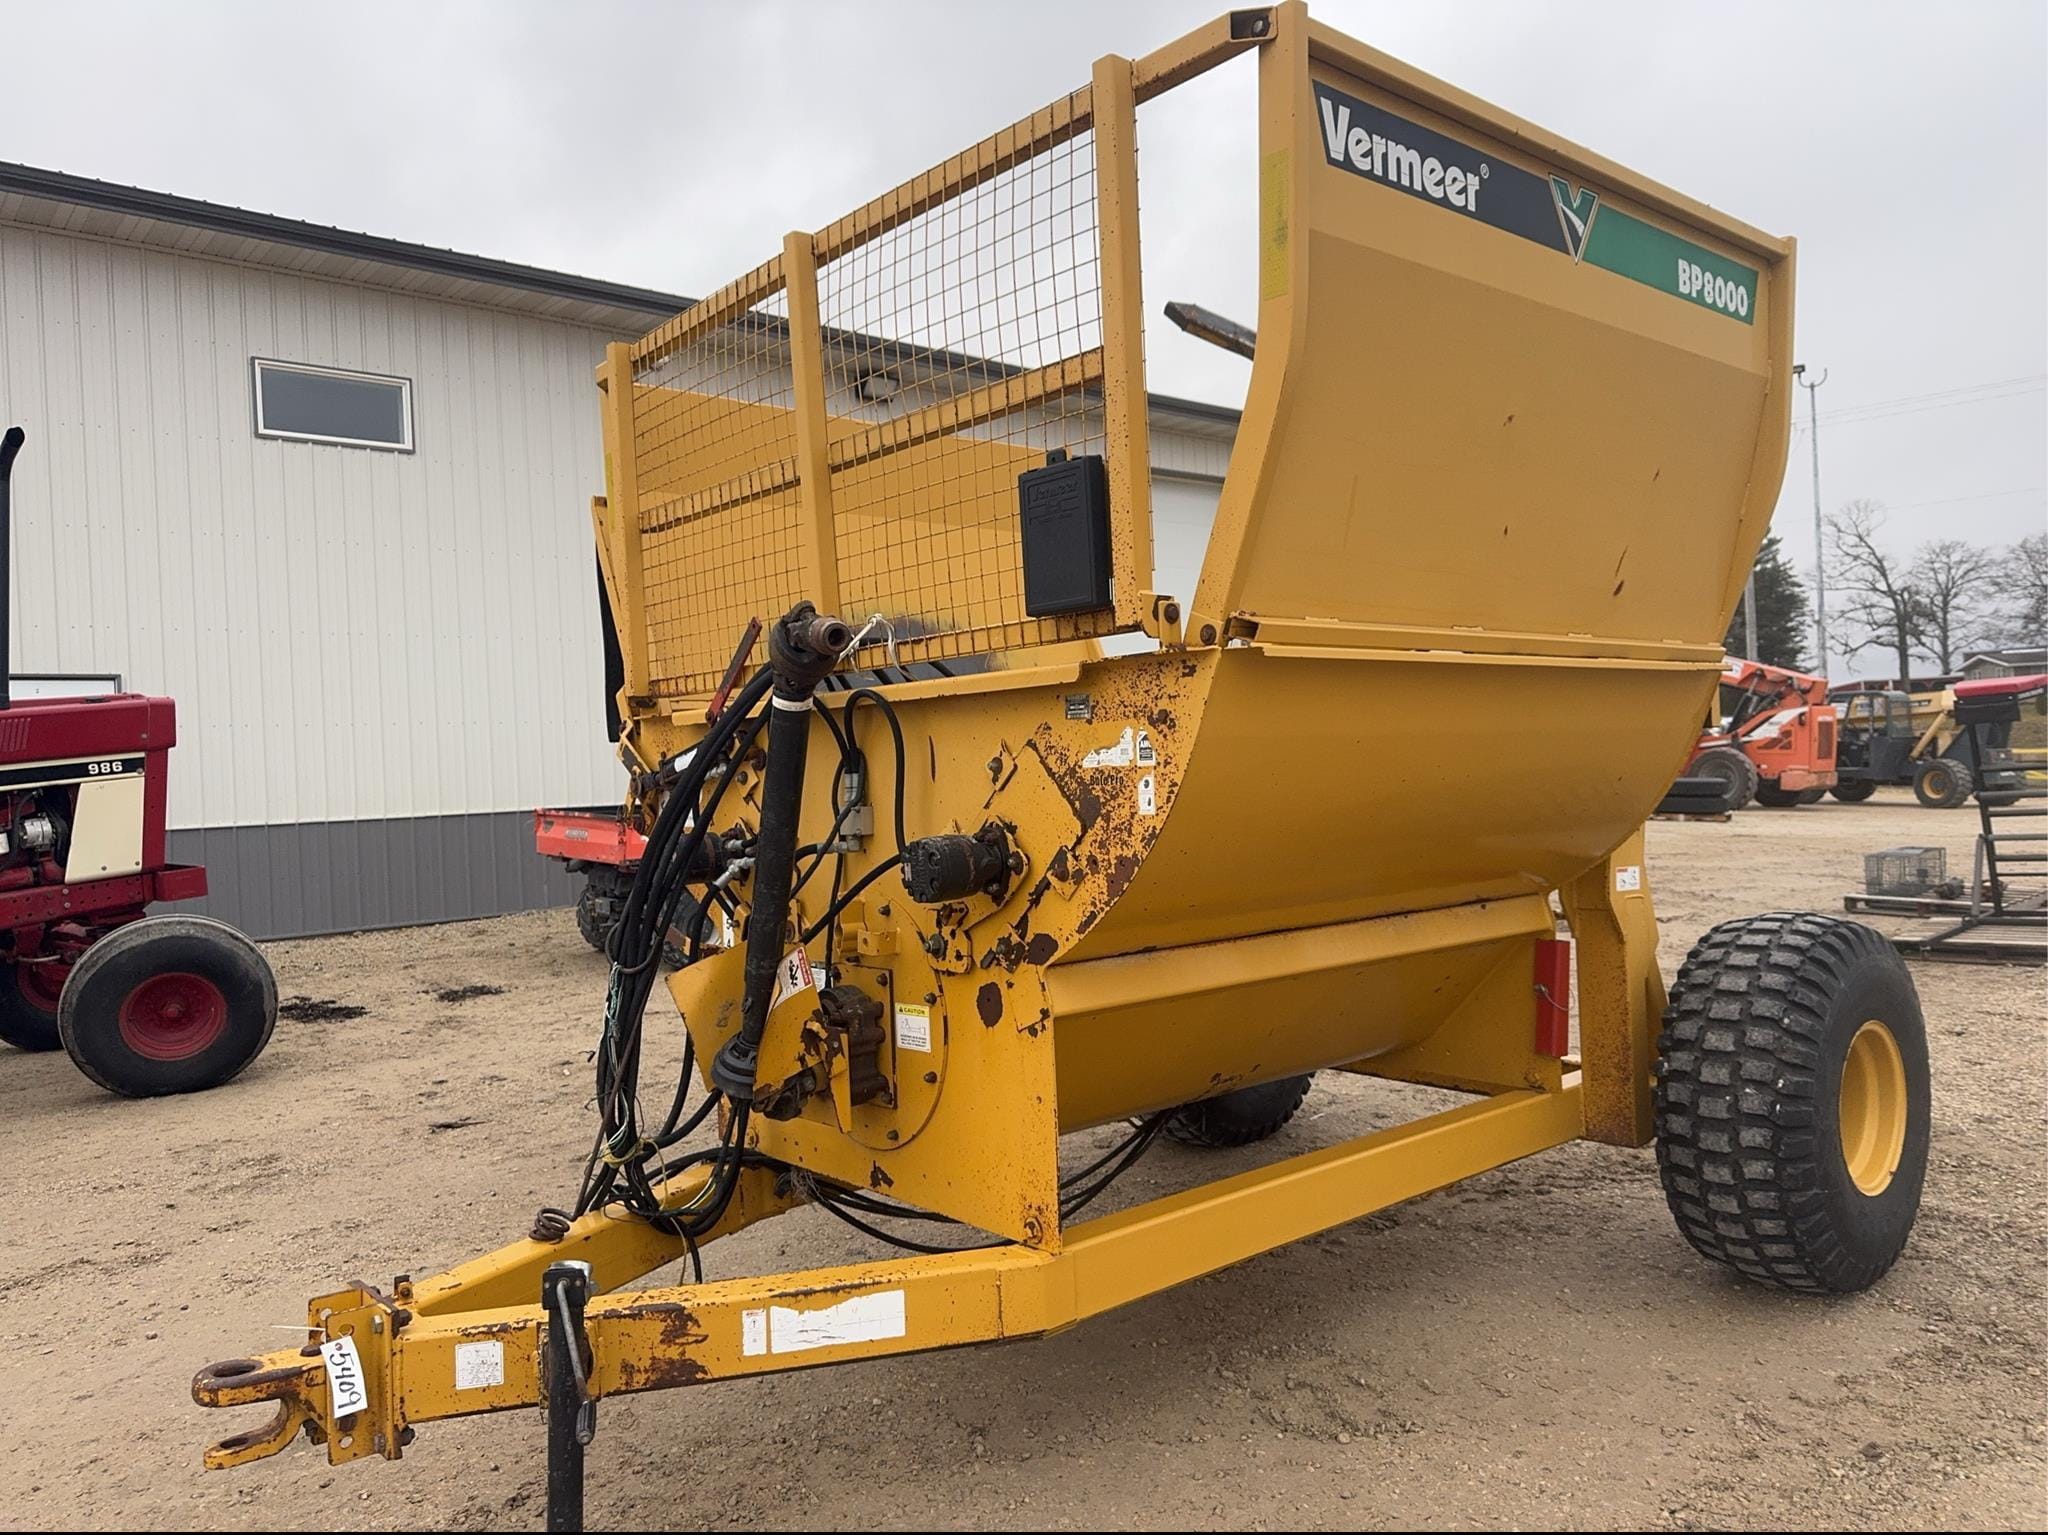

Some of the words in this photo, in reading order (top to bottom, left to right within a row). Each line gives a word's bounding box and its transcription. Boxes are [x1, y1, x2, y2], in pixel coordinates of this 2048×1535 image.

[1319, 96, 1481, 212] Vermeer
[1677, 258, 1749, 317] BP8000
[88, 761, 124, 775] 986
[329, 1352, 362, 1410] 5409
